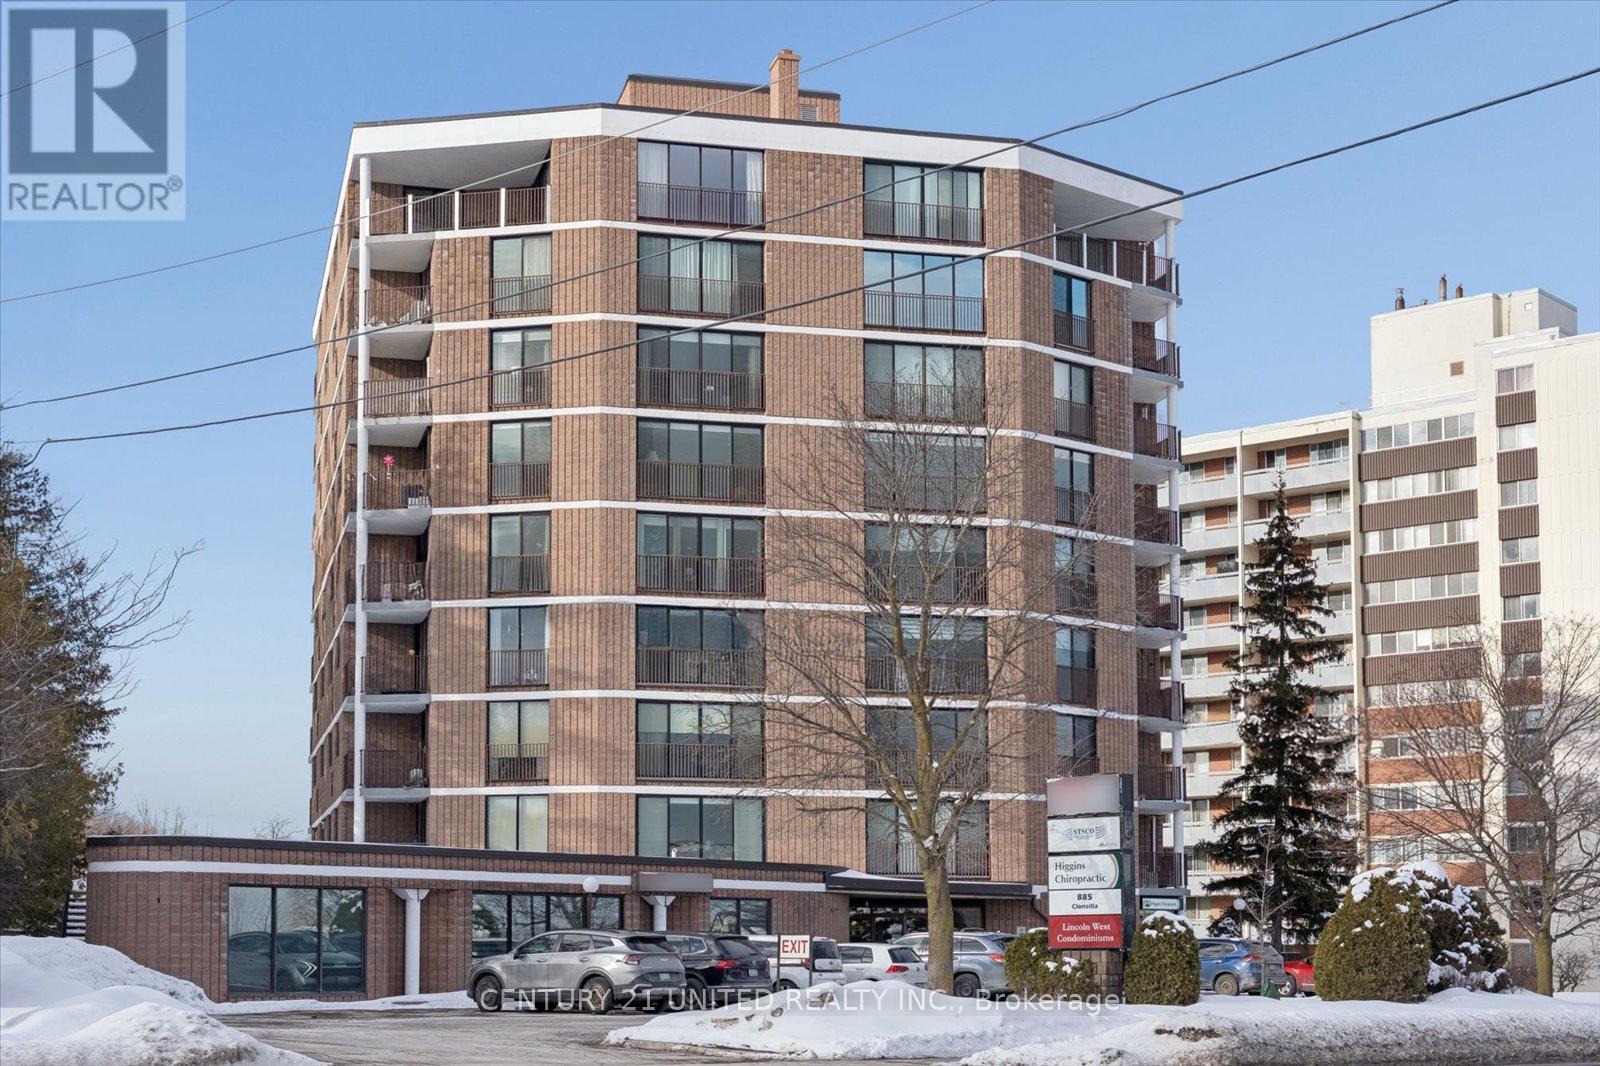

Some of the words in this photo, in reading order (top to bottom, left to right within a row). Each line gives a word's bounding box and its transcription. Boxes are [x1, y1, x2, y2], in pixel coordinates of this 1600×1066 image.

[1055, 861, 1086, 872] Higgins
[1055, 873, 1107, 885] Chiropractic
[1077, 893, 1093, 901] 885
[1062, 923, 1091, 931] Lincoln
[1092, 922, 1111, 930] West
[1056, 933, 1115, 943] Condominiums
[782, 939, 808, 954] EXIT
